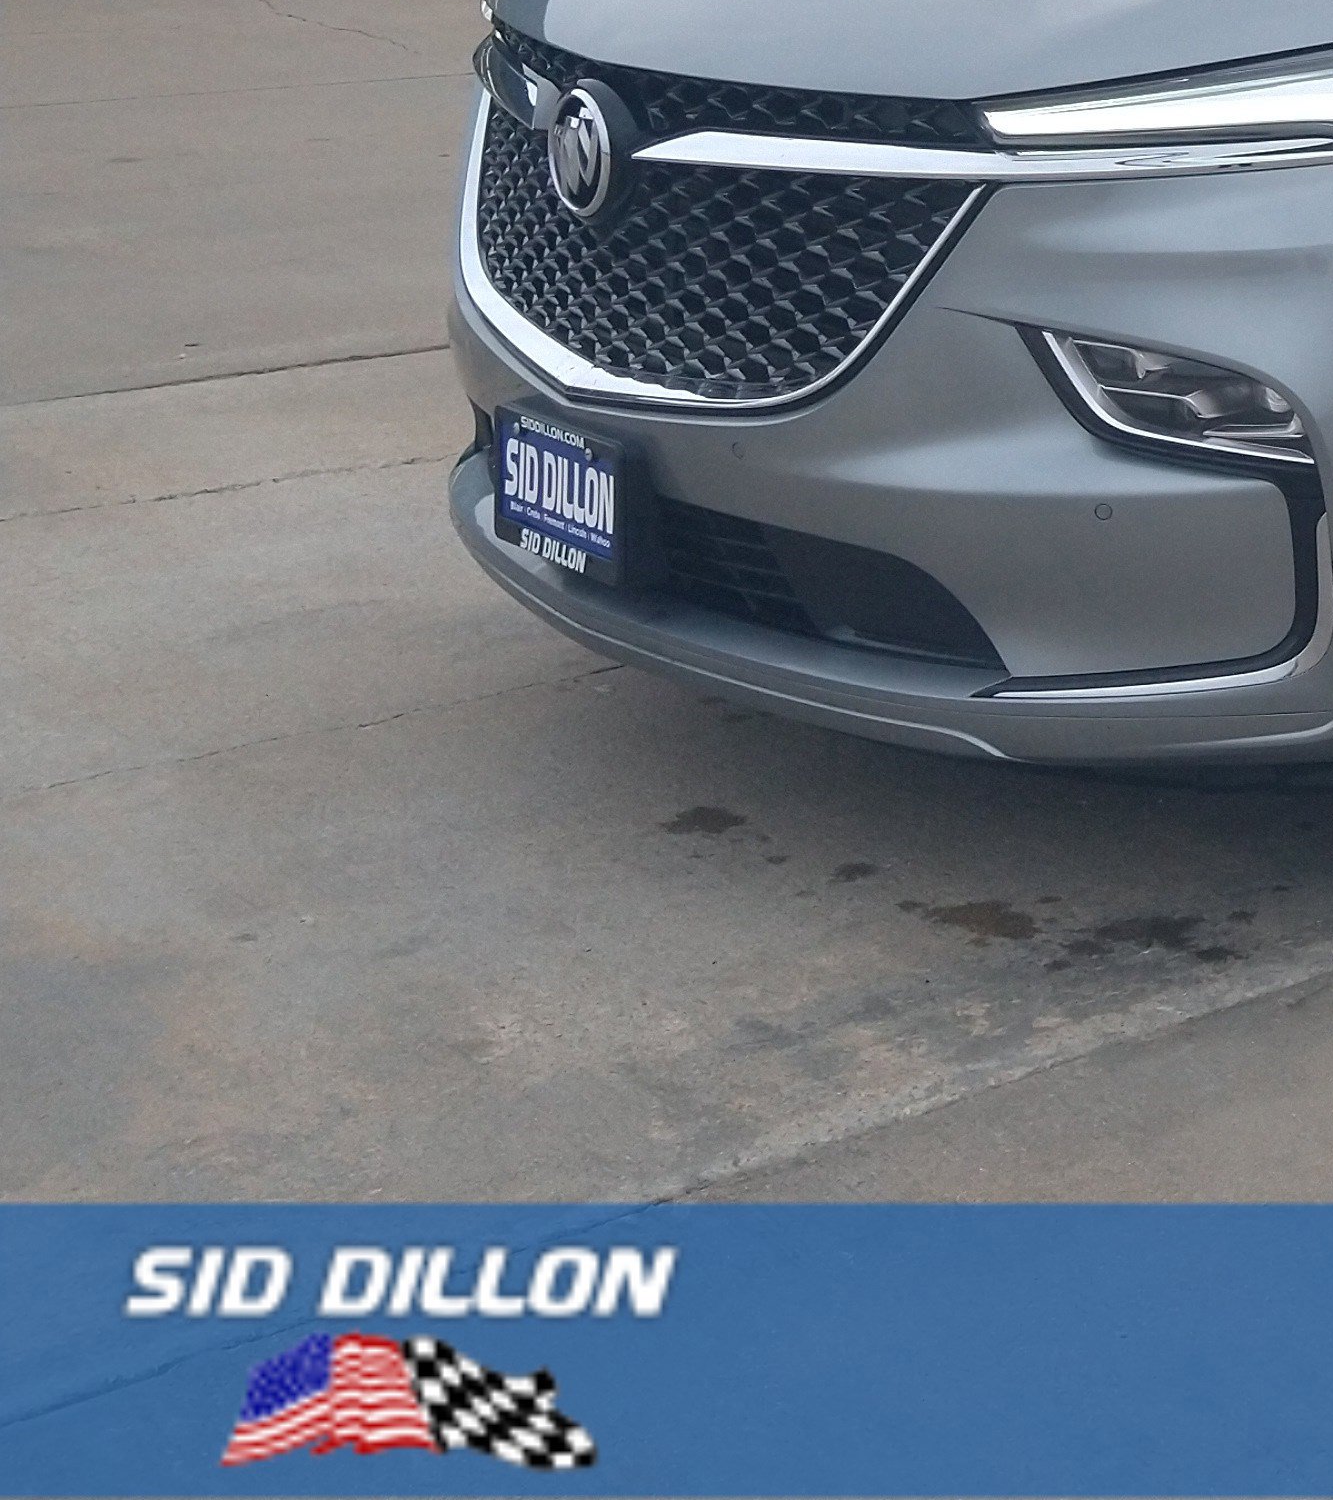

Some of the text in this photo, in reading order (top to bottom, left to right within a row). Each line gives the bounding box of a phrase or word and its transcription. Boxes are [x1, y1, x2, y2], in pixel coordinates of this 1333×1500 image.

[520, 415, 585, 450] SIDDILLON.COM
[504, 438, 615, 535] SID DILLON
[520, 527, 587, 574] SID DILLON
